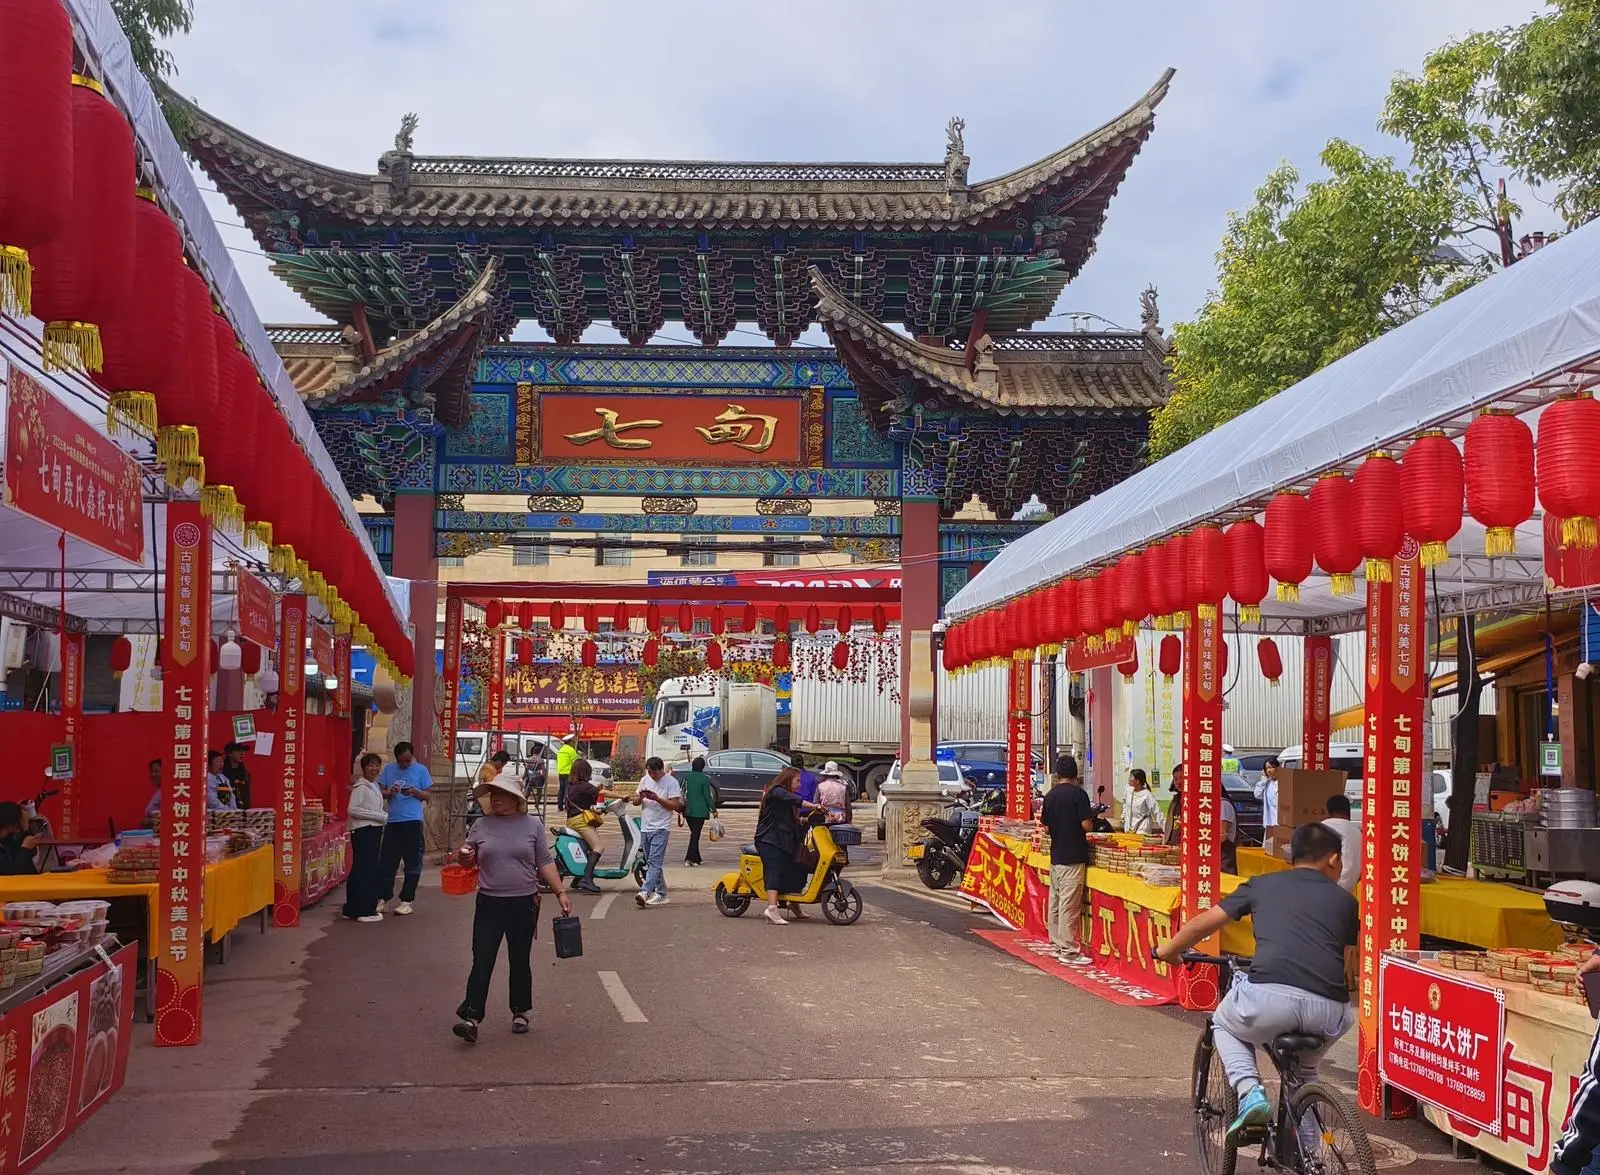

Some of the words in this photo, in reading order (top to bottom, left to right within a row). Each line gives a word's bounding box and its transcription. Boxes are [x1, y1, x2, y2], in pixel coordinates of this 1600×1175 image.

[563, 403, 779, 453] 七甸
[180, 551, 192, 599] 古驿传香
[1399, 564, 1411, 618] 古驿传香
[179, 603, 191, 652] 味美七甸
[1398, 623, 1410, 677] 味美七甸
[1202, 651, 1212, 691] 味美七甸
[170, 685, 193, 962] 七甸第四届大饼文化·中秋美食节
[1197, 717, 1214, 942] 七甸第四届大饼文化·中秋美
[1389, 1003, 1488, 1060] 七甸盛源大饼厂
[1394, 1037, 1480, 1082] 所有工序及原材料均是纯手工制作
